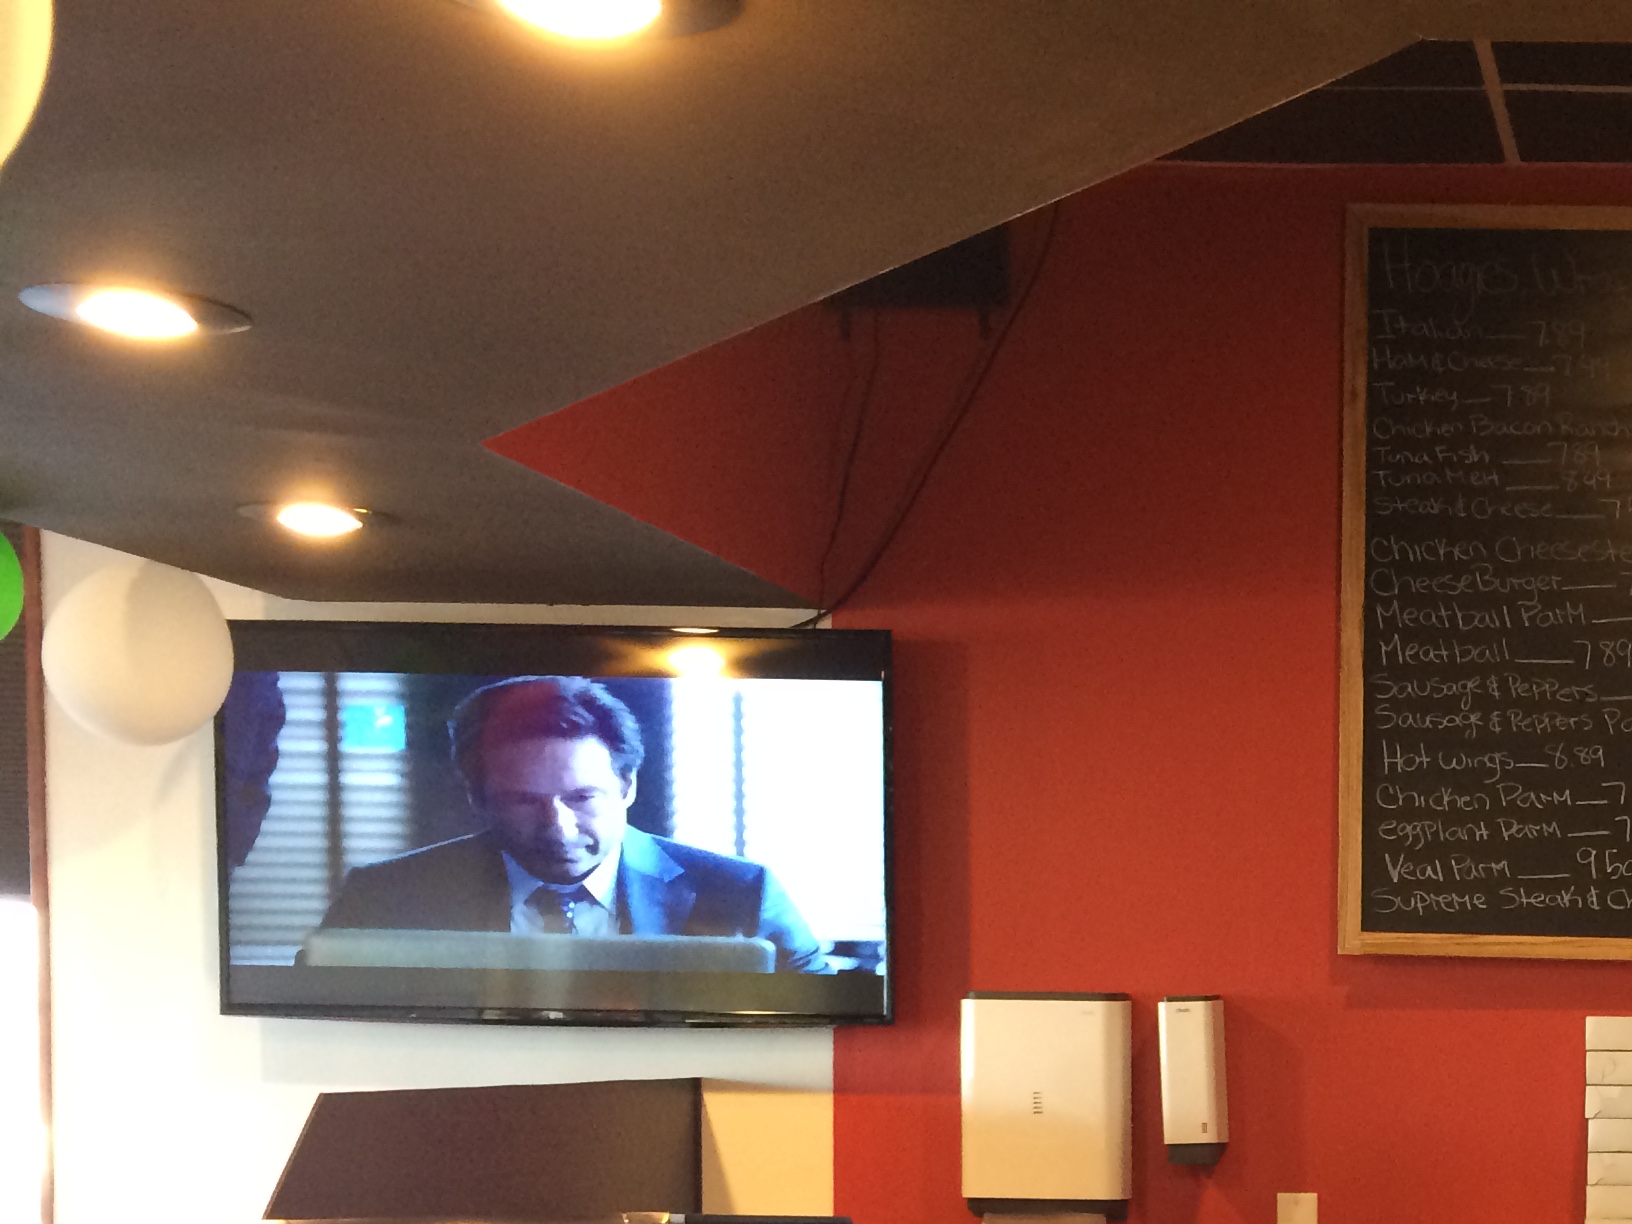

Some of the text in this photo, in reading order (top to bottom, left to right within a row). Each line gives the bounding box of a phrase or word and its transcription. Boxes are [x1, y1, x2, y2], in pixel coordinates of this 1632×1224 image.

[1371, 382, 1459, 410] Turkey
[1372, 418, 1461, 439] Chicken
[1469, 414, 1552, 436] Bacon
[1373, 447, 1430, 465] Tuna
[1437, 446, 1490, 464] Fish
[1374, 470, 1441, 487] Tuna
[1471, 499, 1553, 519] Cheese
[1371, 537, 1485, 563] Chicken
[1377, 604, 1510, 630] Meatball
[1518, 601, 1585, 627] Parm
[1381, 634, 1510, 665] Meatball
[1372, 673, 1482, 710] Sausage
[1375, 705, 1482, 739] Sausage
[1383, 740, 1431, 774] Hot
[1377, 783, 1490, 811] Chicken
[1496, 783, 1570, 810] Parm
[1500, 817, 1561, 840] Parm
[1384, 854, 1442, 883] Veal
